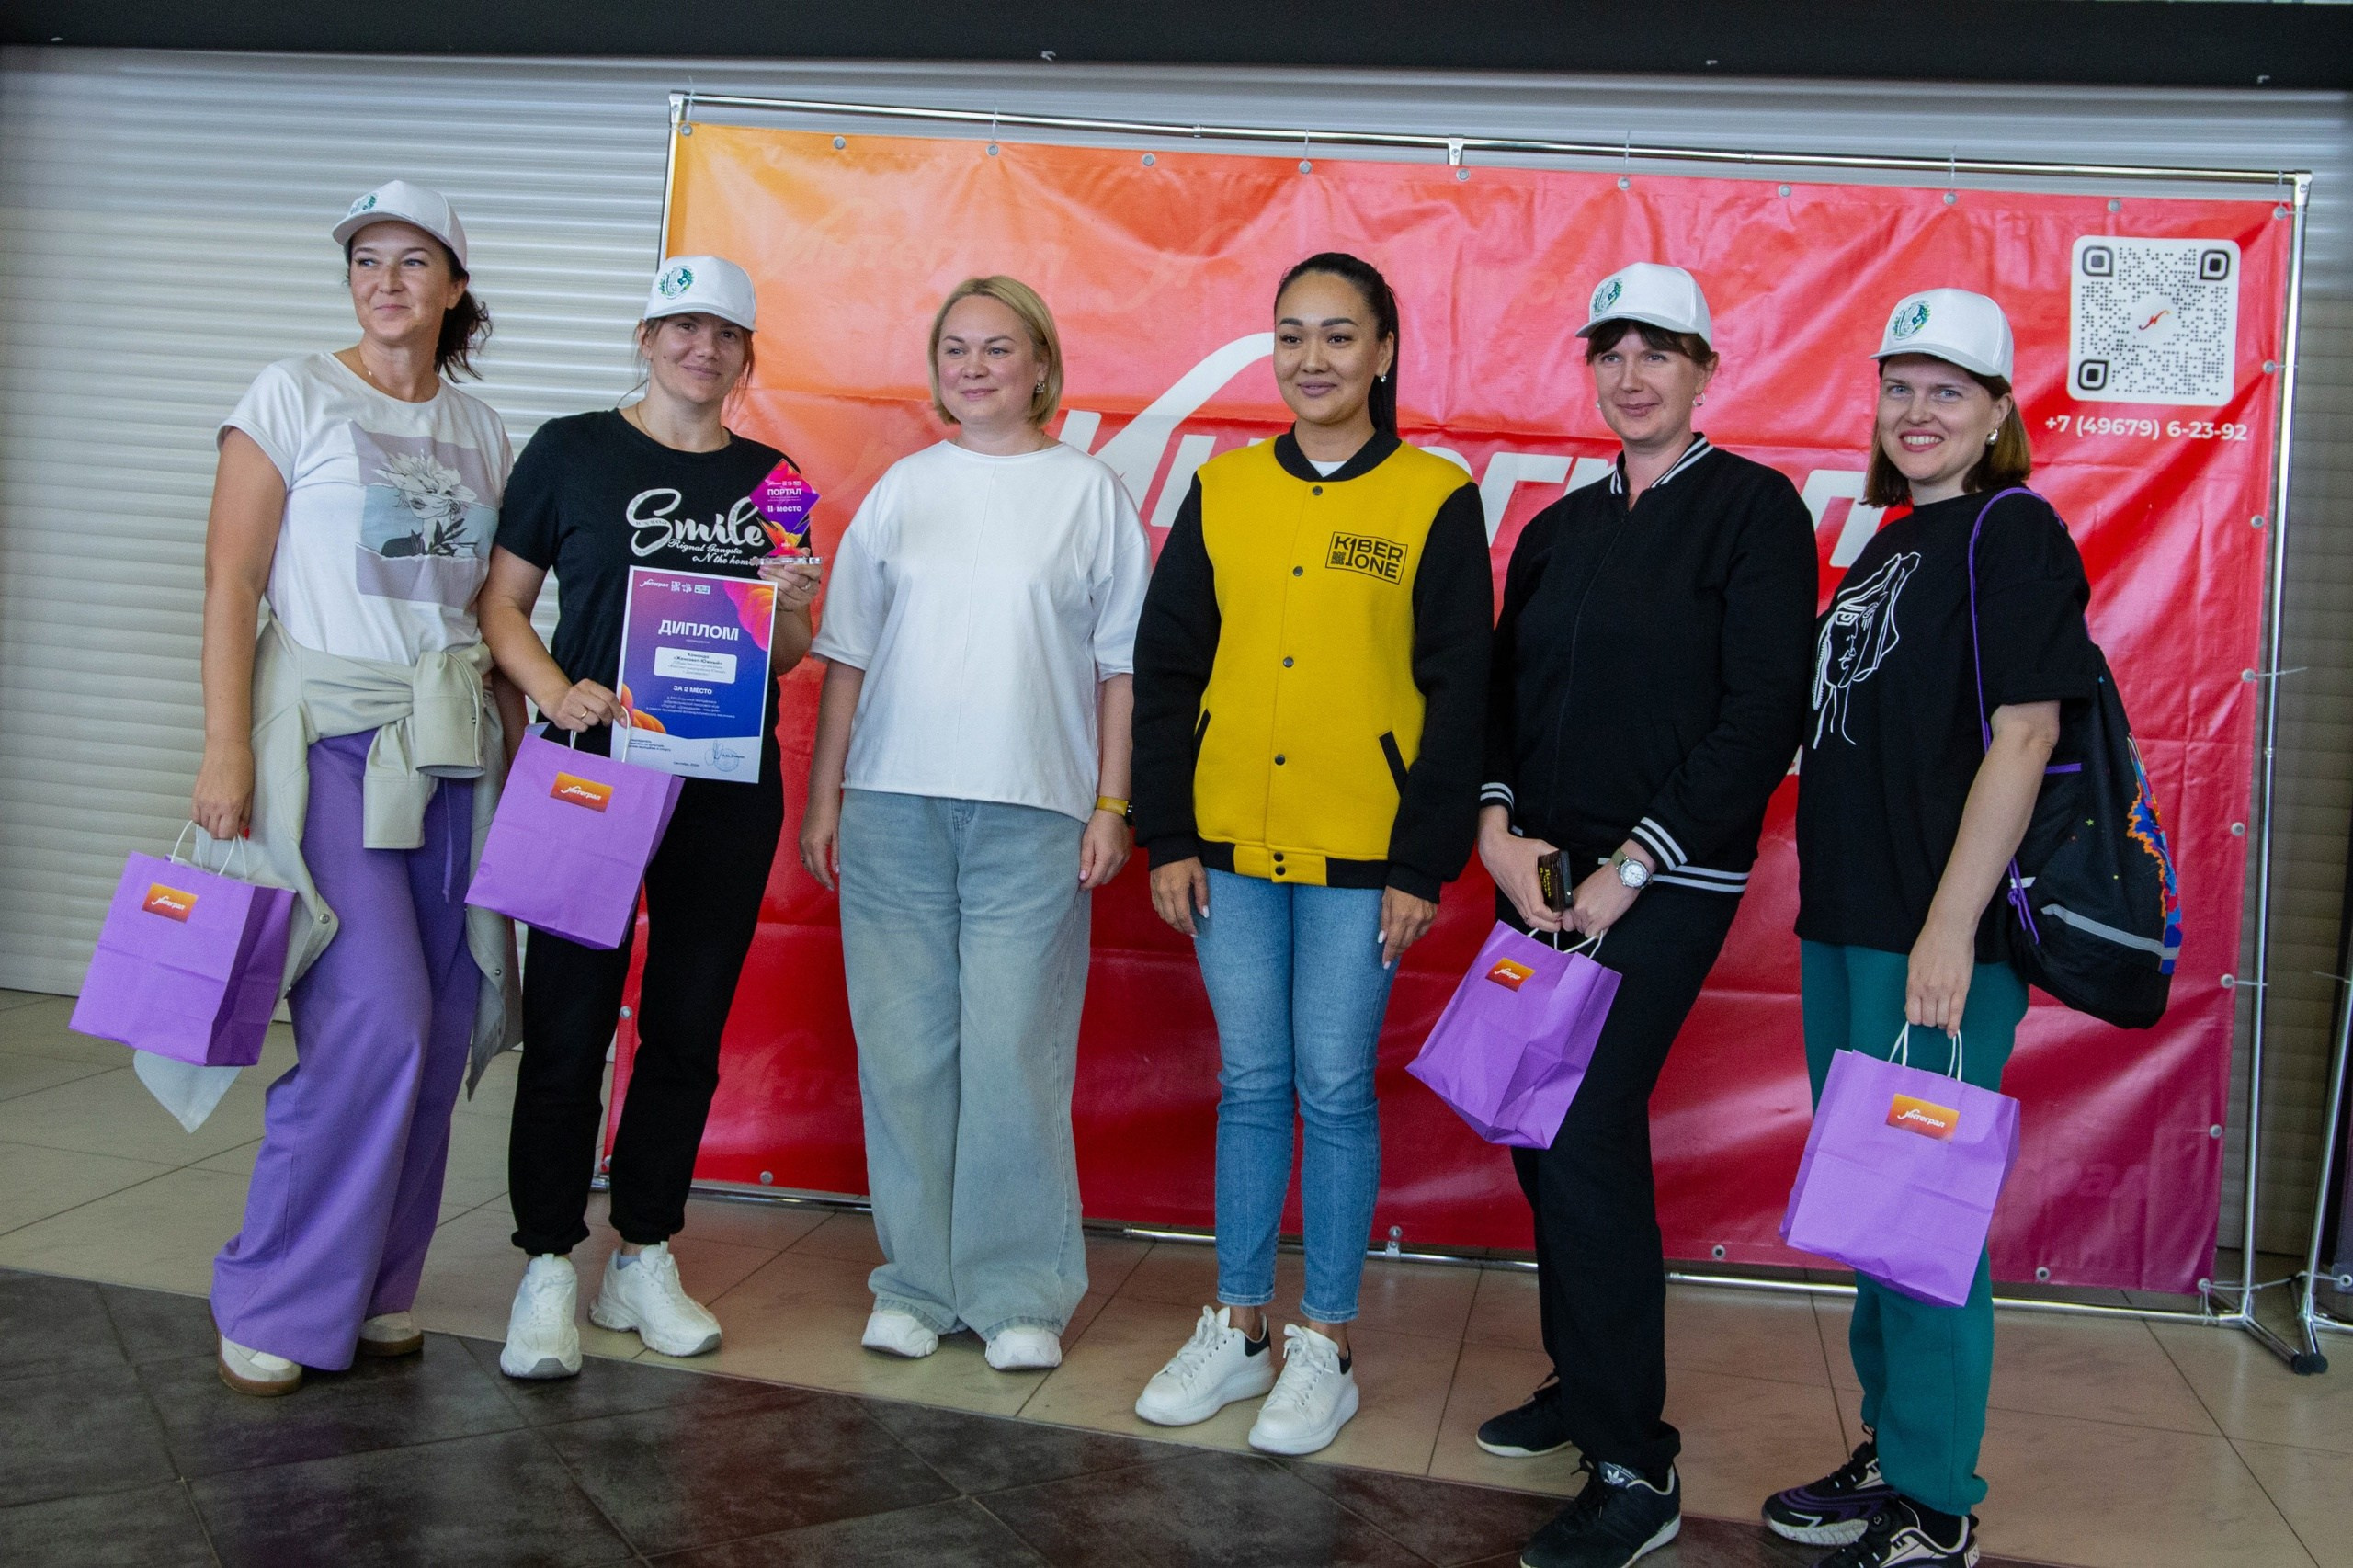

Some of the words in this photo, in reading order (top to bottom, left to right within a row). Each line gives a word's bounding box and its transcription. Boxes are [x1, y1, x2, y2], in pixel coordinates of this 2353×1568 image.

[2045, 415, 2071, 432] +7
[2075, 415, 2160, 440] (49679)
[2166, 420, 2247, 441] 6-23-92
[626, 488, 765, 557] Smile
[658, 619, 739, 641] ДИПЛОМ
